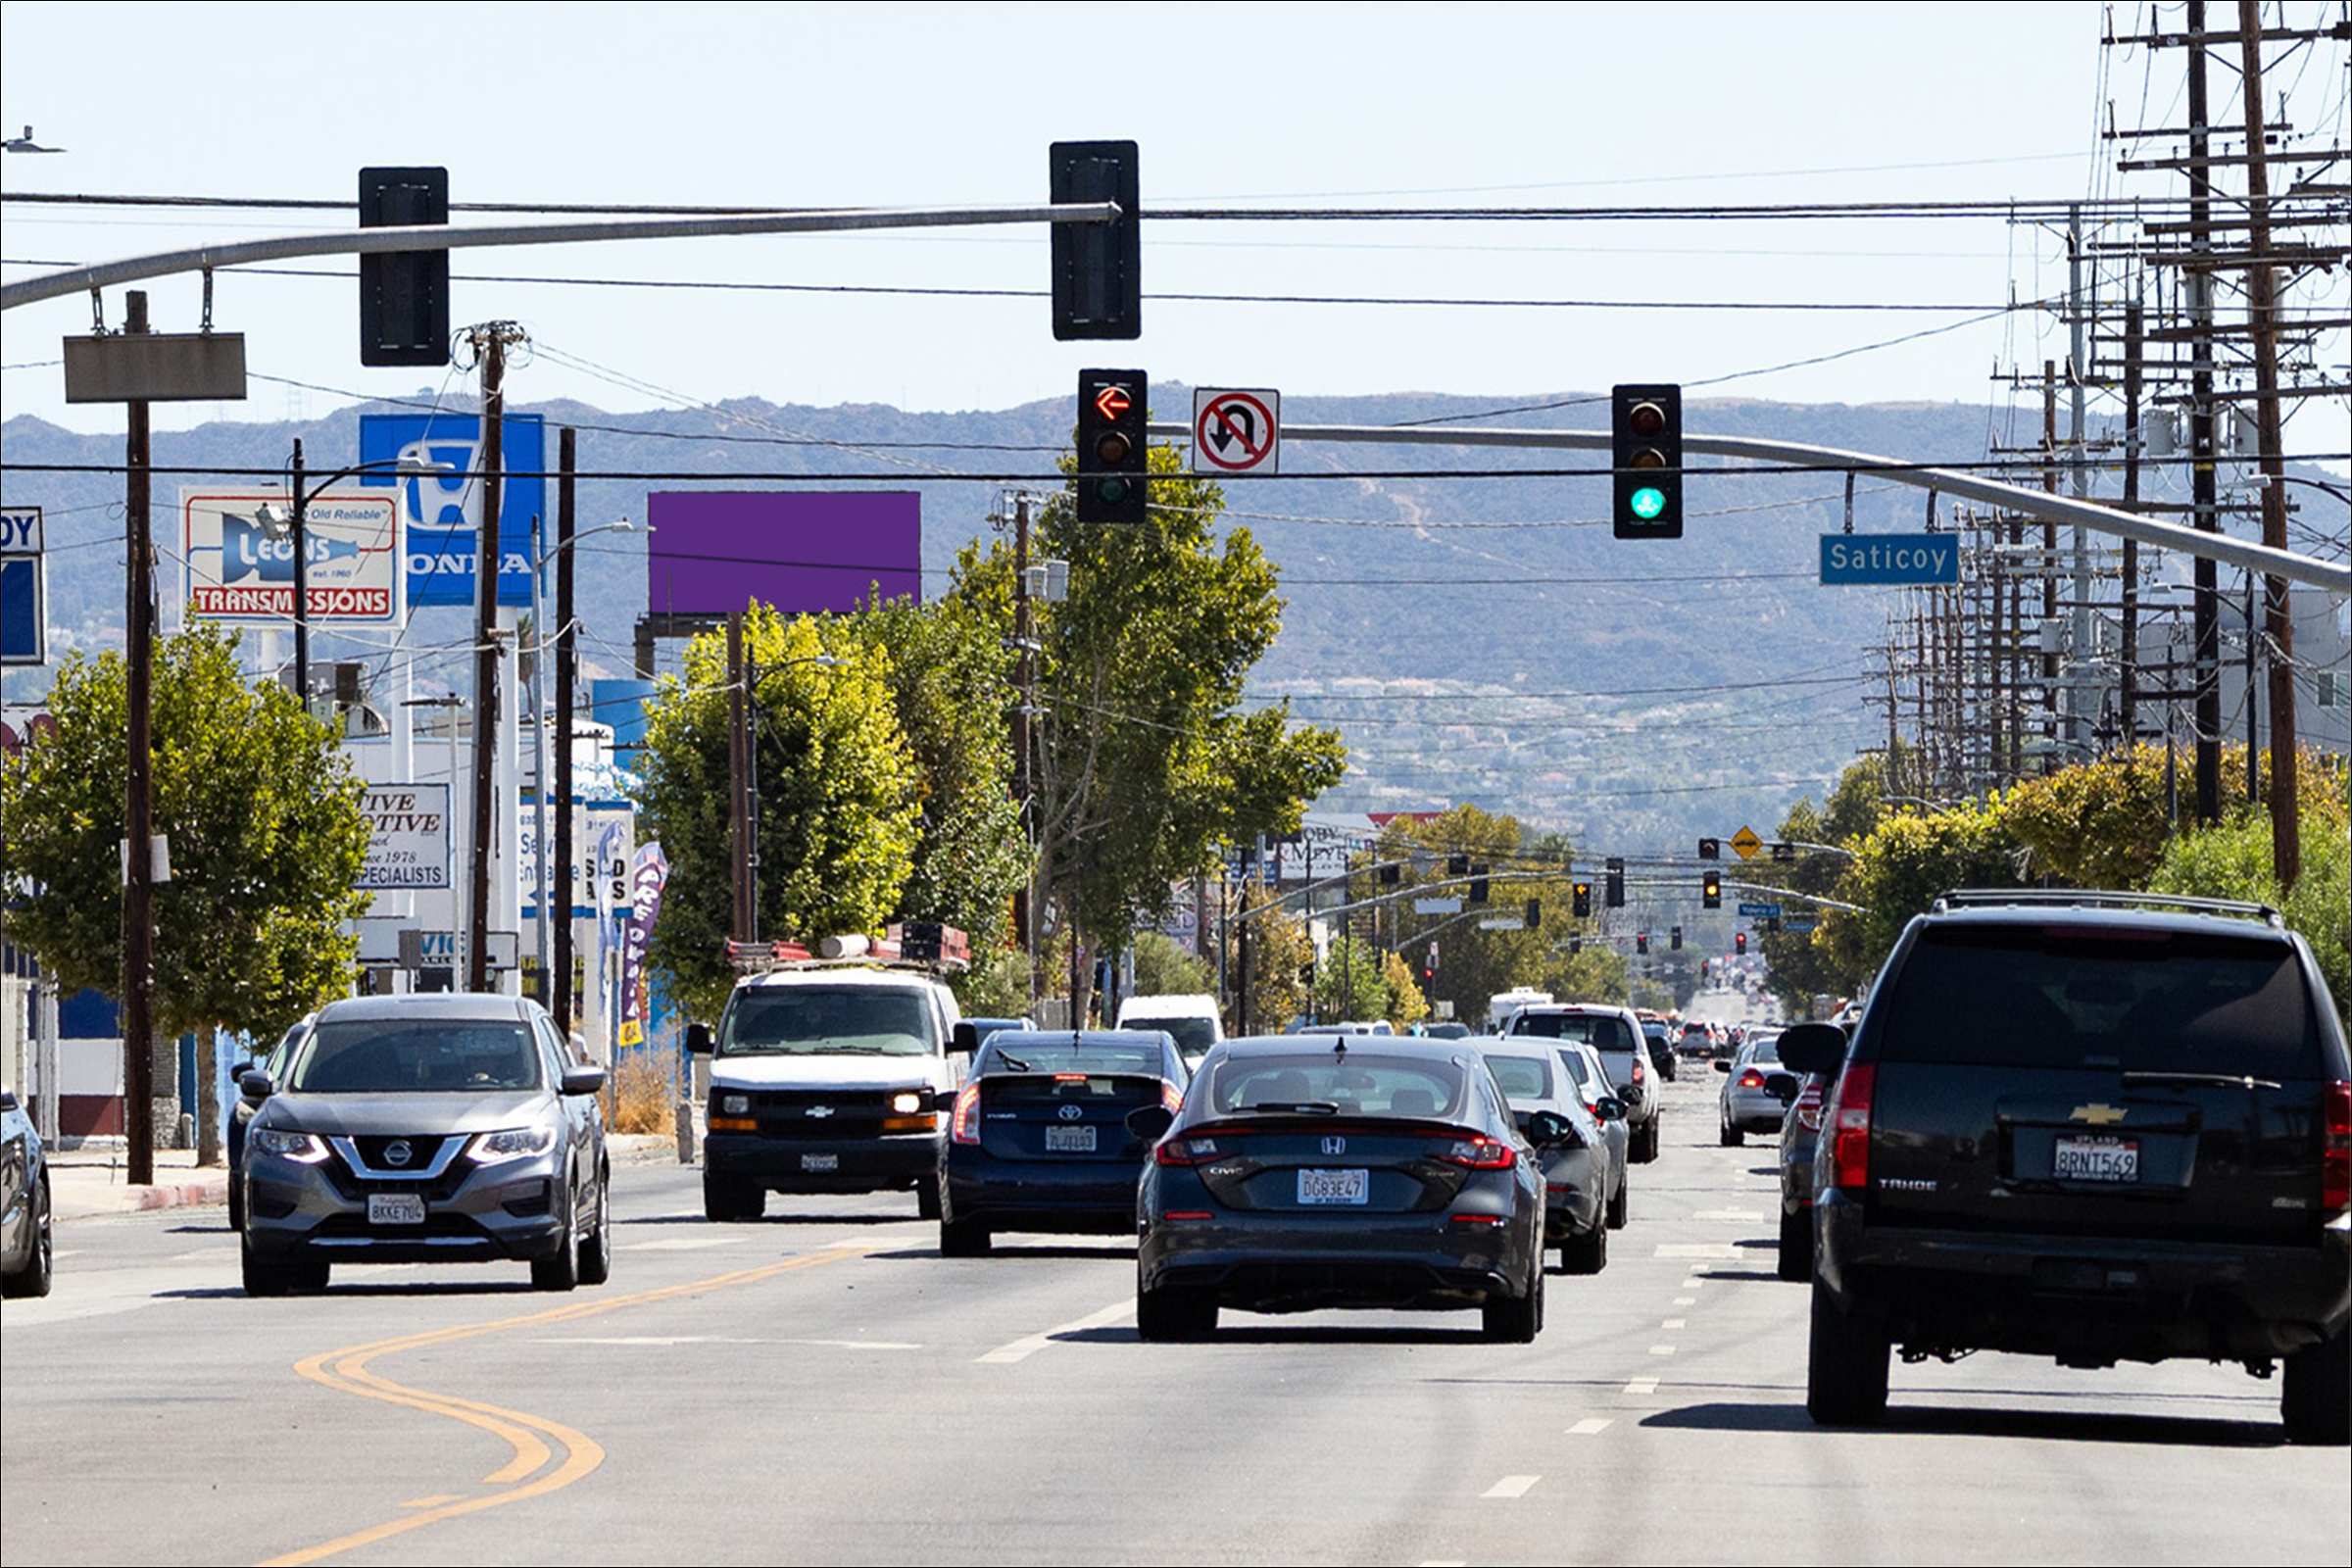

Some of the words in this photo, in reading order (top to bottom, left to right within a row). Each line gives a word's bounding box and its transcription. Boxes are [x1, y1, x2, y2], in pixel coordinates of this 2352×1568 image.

[311, 509, 331, 520] Old
[407, 553, 532, 574] ONA
[1830, 543, 1947, 575] Saticoy
[196, 590, 387, 613] TRANSMSSIONS
[385, 851, 416, 864] 1978
[357, 866, 442, 884] PECIALISTS
[2076, 1135, 2119, 1146] UPLAND
[2058, 1151, 2134, 1176] 8RNT569
[1879, 1178, 1937, 1192] TAHOE
